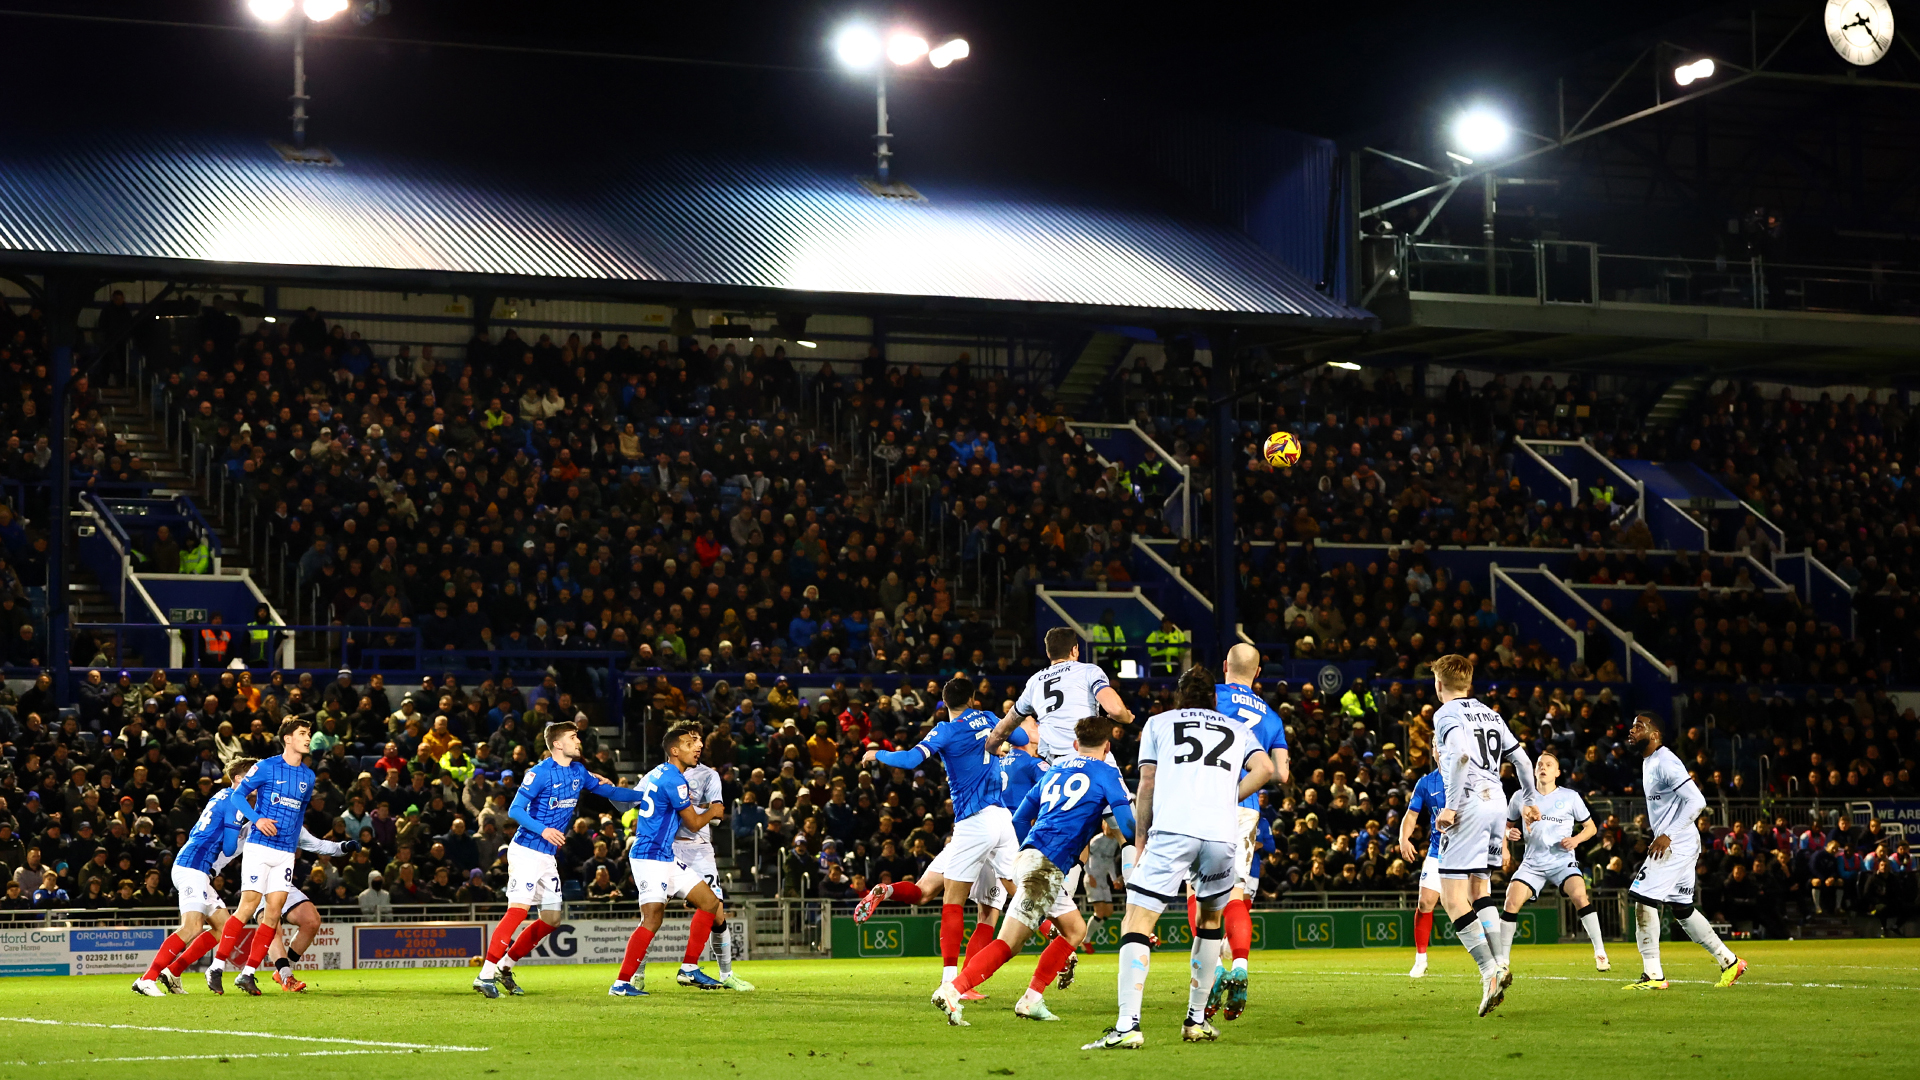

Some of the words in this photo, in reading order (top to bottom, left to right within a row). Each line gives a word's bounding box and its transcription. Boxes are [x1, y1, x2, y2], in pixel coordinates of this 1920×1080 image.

[1043, 676, 1065, 713] 5
[1231, 693, 1268, 715] OGILVIE
[1180, 711, 1226, 723] CRAMA
[1173, 721, 1235, 772] 52
[1473, 728, 1502, 773] 19
[1061, 760, 1087, 769] LANG
[1040, 772, 1091, 813] 49
[1877, 808, 1895, 820] WE
[1897, 808, 1920, 820] ARE
[283, 867, 293, 883] 8
[76, 932, 120, 940] ORCHARD
[122, 931, 154, 940] BLINDS
[395, 929, 447, 938] ACCESS
[1157, 925, 1191, 945] L&S
[1297, 922, 1330, 942] L&S
[1366, 921, 1398, 941] L&S
[31, 932, 66, 943] Court
[405, 939, 437, 948] 2000
[863, 929, 899, 950] L&S
[374, 948, 467, 958] SCAFFOLDING
[593, 946, 609, 954] Call
[110, 953, 123, 961] 811
[359, 960, 383, 969] 07775
[385, 960, 402, 968] 617
[403, 960, 416, 968] 118
[451, 959, 466, 967] 783
